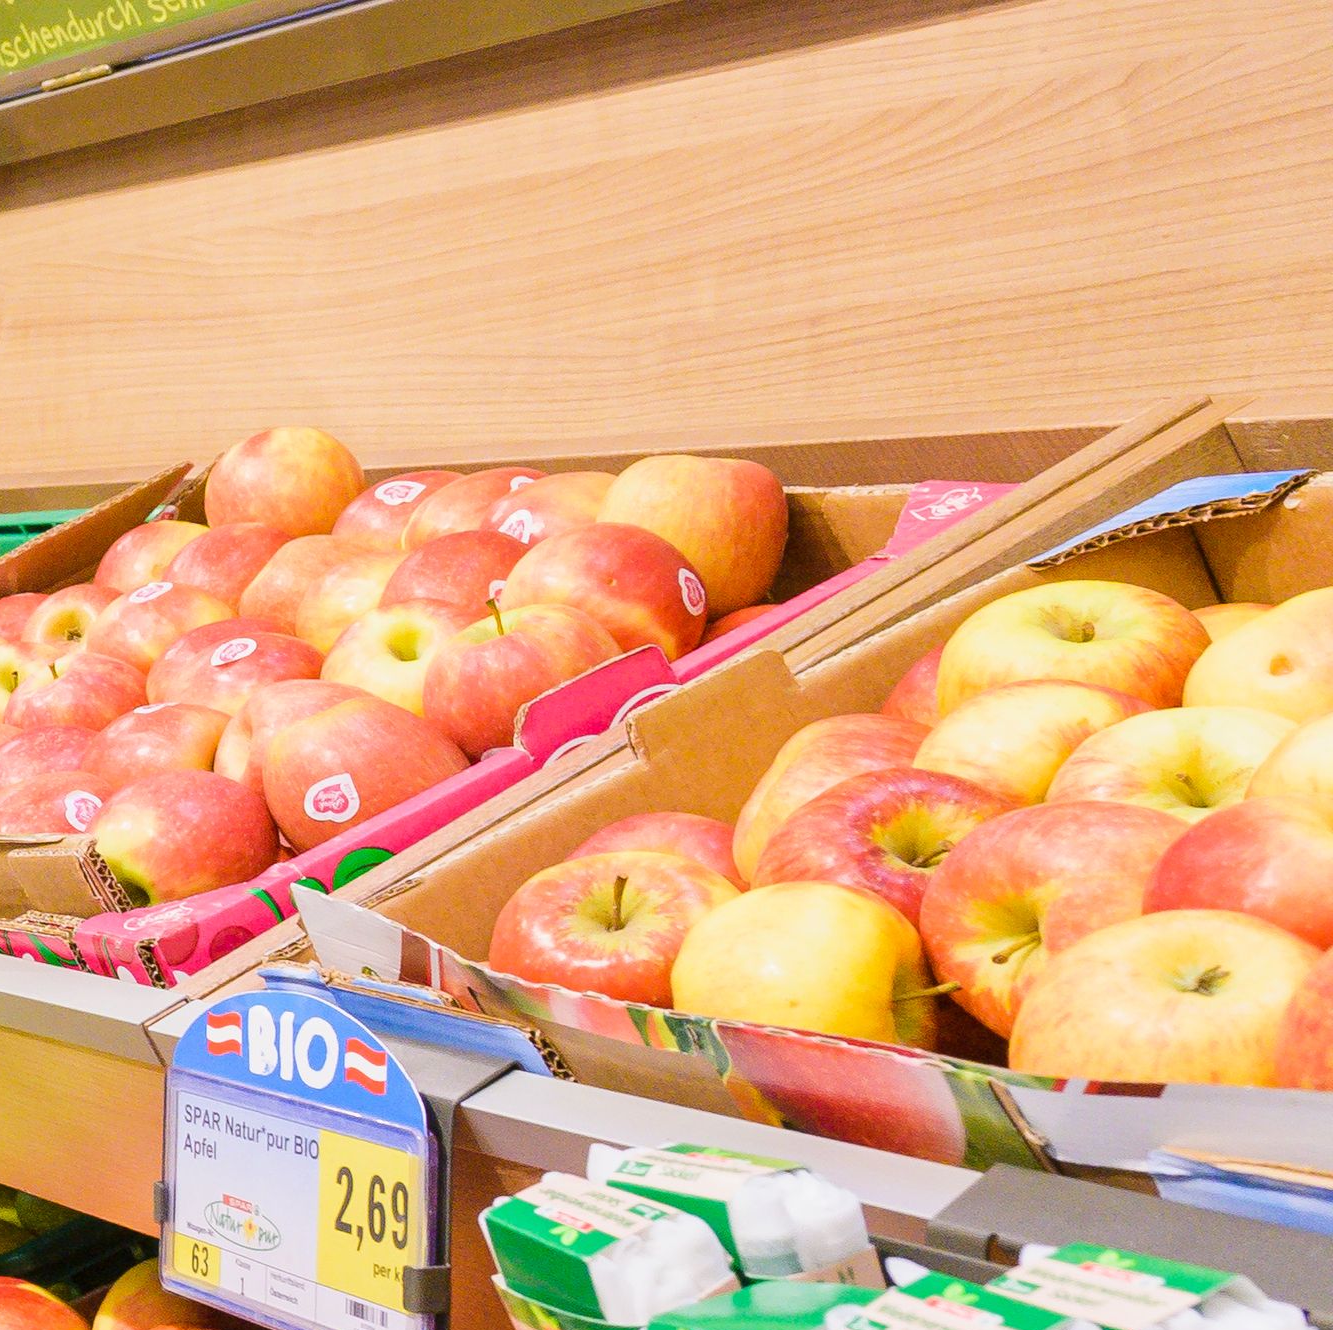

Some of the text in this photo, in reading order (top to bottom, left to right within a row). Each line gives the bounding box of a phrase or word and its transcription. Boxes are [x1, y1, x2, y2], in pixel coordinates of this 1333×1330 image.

[247, 1003, 340, 1090] BIO
[184, 1104, 221, 1132] SPAR
[294, 1134, 320, 1160] BIO
[184, 1133, 218, 1160] Apfel
[335, 1166, 410, 1251] 2,69
[191, 1243, 210, 1277] 63
[373, 1262, 391, 1279] per
